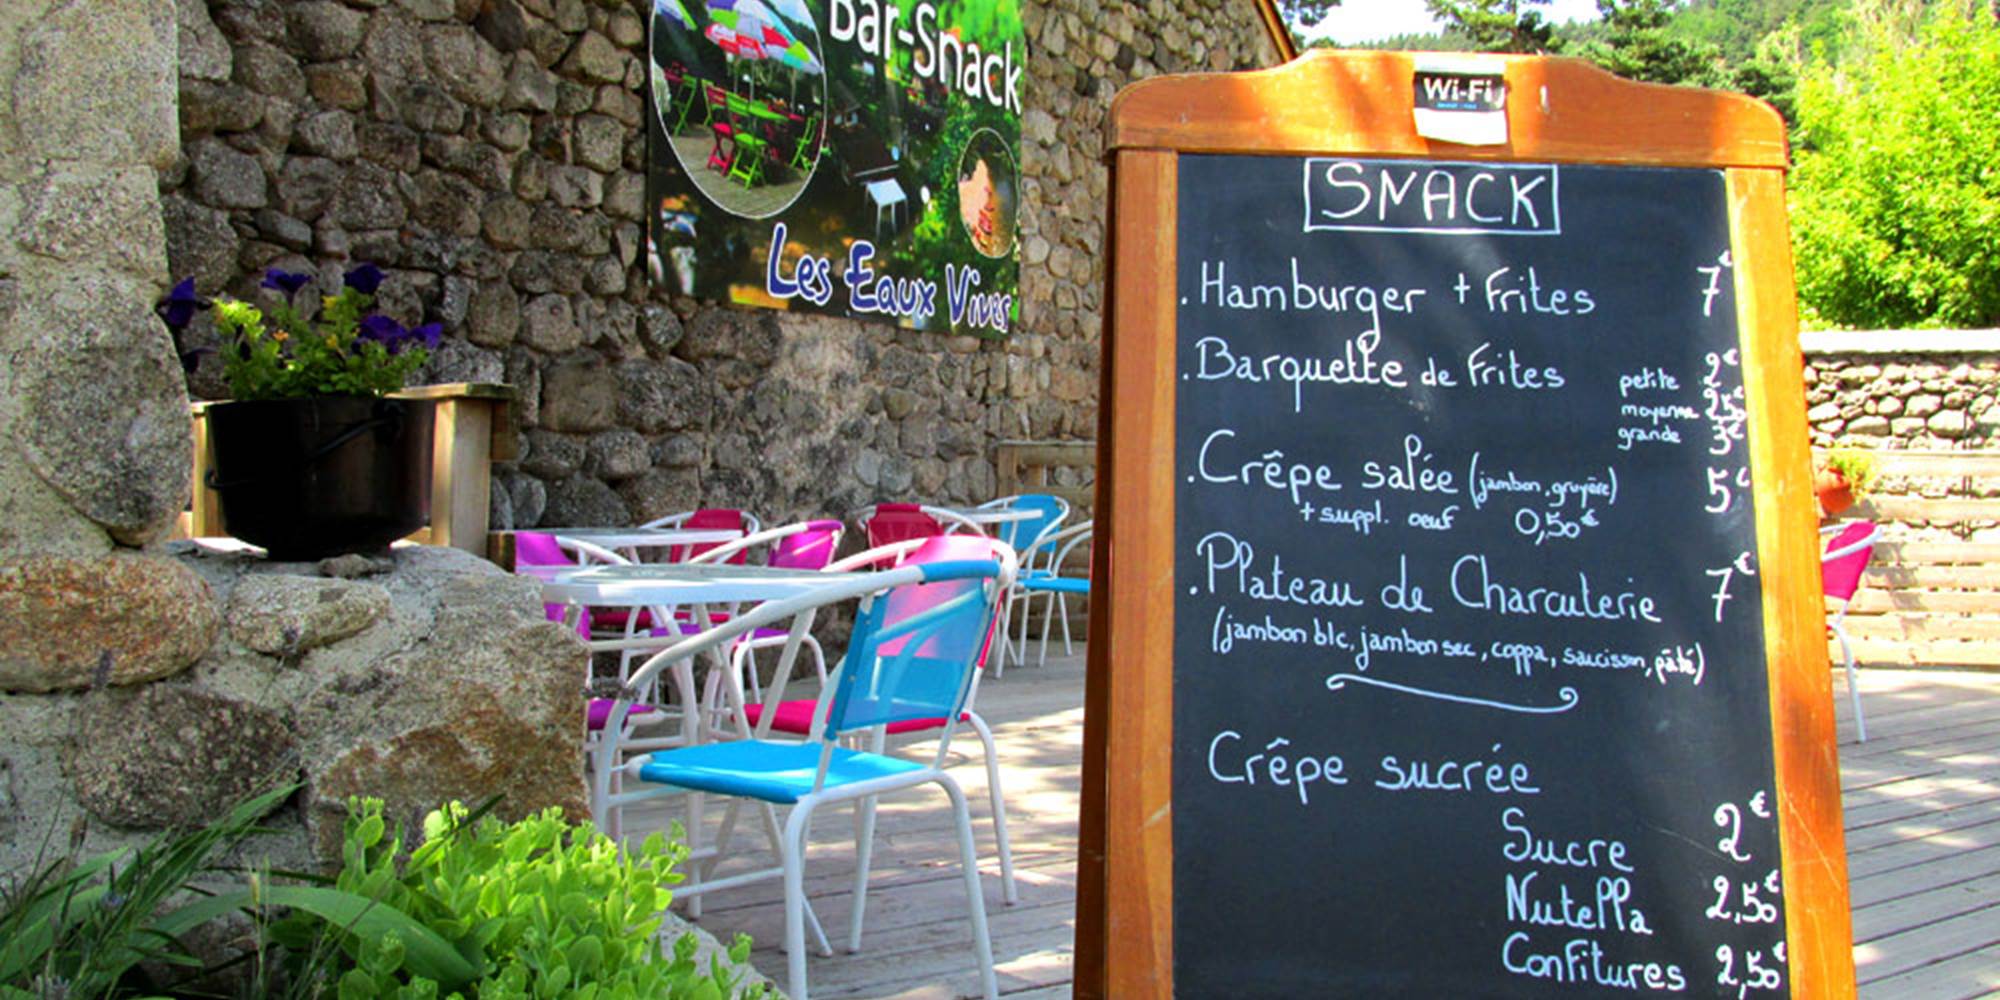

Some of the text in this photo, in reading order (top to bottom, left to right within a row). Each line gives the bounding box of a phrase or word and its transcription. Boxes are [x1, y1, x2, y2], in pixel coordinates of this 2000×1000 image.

[829, 0, 1022, 114] Bar-Snack
[1424, 77, 1492, 102] Wi-Fi
[1321, 162, 1545, 228] SNACK
[767, 222, 1013, 334] Les Eaux Vives
[1201, 257, 1426, 353] Hamburger
[1453, 273, 1471, 304] +
[1196, 336, 1408, 413] Barquette
[1420, 358, 1457, 387] de
[1619, 367, 1680, 397] petite
[1199, 429, 1342, 505] Crêpe
[1361, 434, 1459, 493] salée
[1617, 425, 1681, 450] grande
[1197, 531, 1363, 607] Plateau
[1381, 554, 1433, 612] de
[1451, 554, 1662, 623] Charcuterie
[1213, 606, 1307, 653] (jambon
[1209, 730, 1540, 805] Crêpe sucrée
[1502, 807, 1634, 872] Sucre
[1505, 871, 1653, 934] Nutella
[1502, 932, 1686, 991] Confitures
